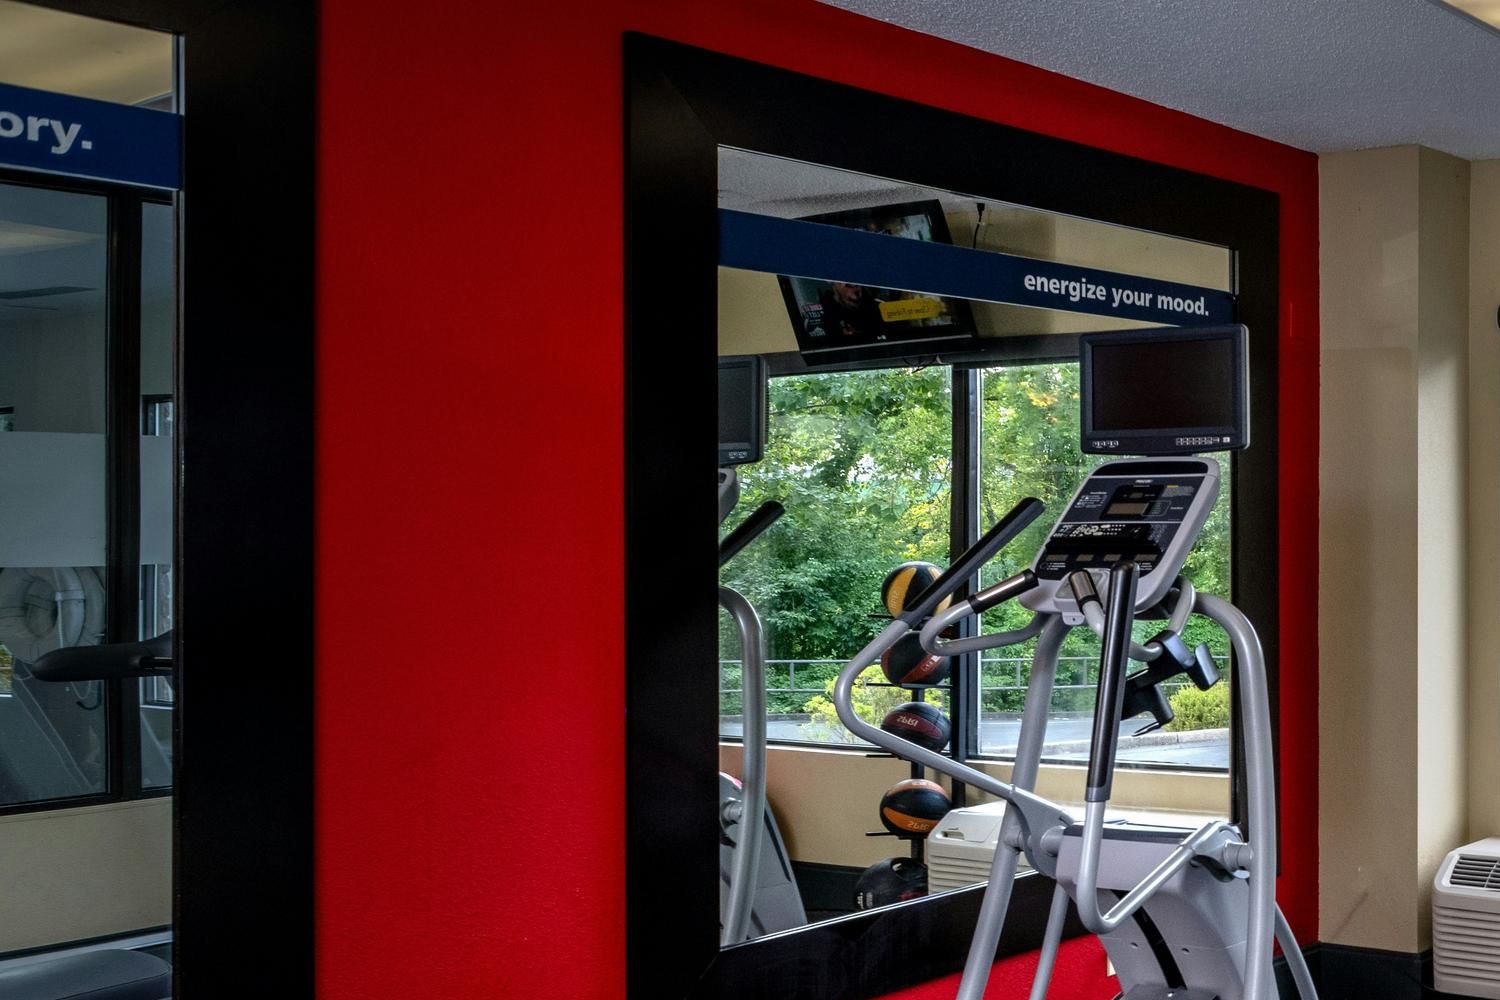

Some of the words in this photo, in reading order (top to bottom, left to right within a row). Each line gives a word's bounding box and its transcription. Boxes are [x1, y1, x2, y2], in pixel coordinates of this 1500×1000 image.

[0, 111, 93, 154] ory.
[1024, 275, 1106, 301] energize
[1112, 285, 1153, 307] your
[1157, 296, 1209, 316] mood.
